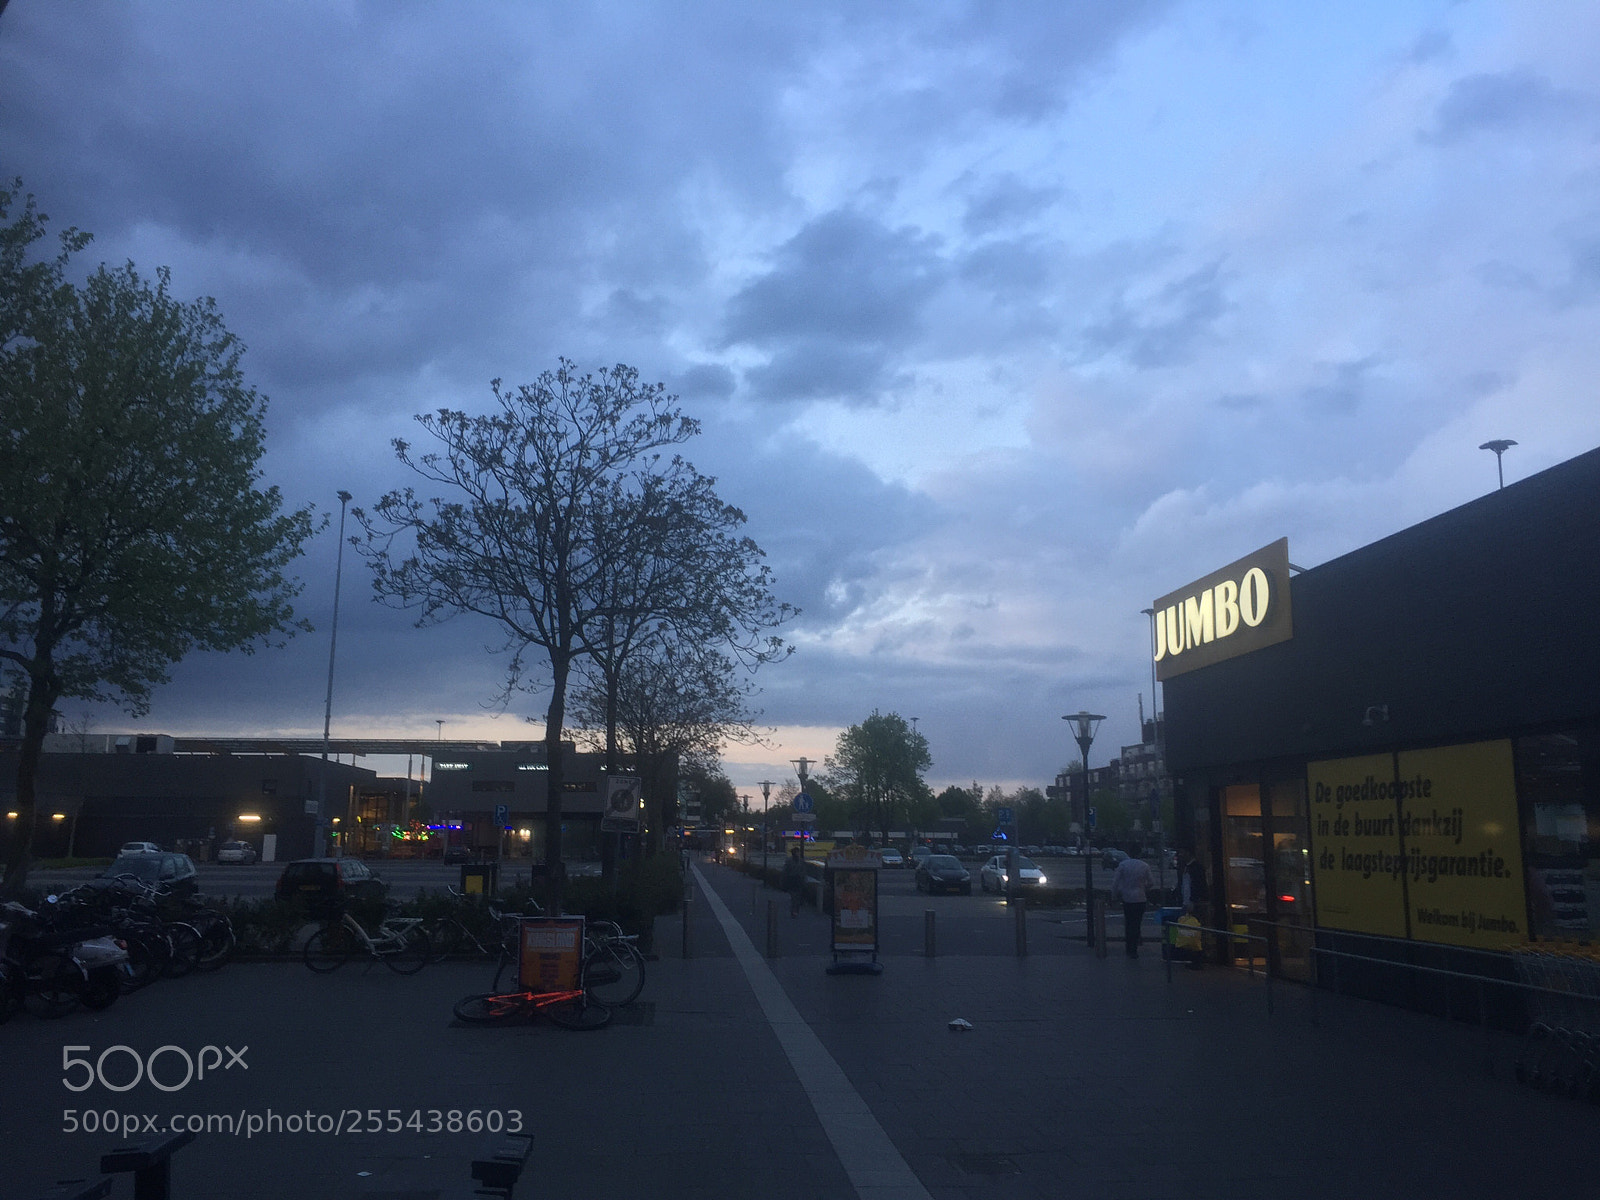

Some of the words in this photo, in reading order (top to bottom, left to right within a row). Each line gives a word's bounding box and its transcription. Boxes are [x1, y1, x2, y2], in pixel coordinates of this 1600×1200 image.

[1155, 567, 1269, 662] JUMBO
[1315, 782, 1331, 803] De
[1337, 776, 1432, 808] goedkoopste
[1317, 814, 1329, 836] in
[1334, 813, 1350, 836] de
[1355, 812, 1394, 837] buurt
[1402, 808, 1463, 844] dankzij
[1319, 847, 1335, 870] de
[1417, 908, 1459, 927] Welkom
[1462, 911, 1476, 934] bij
